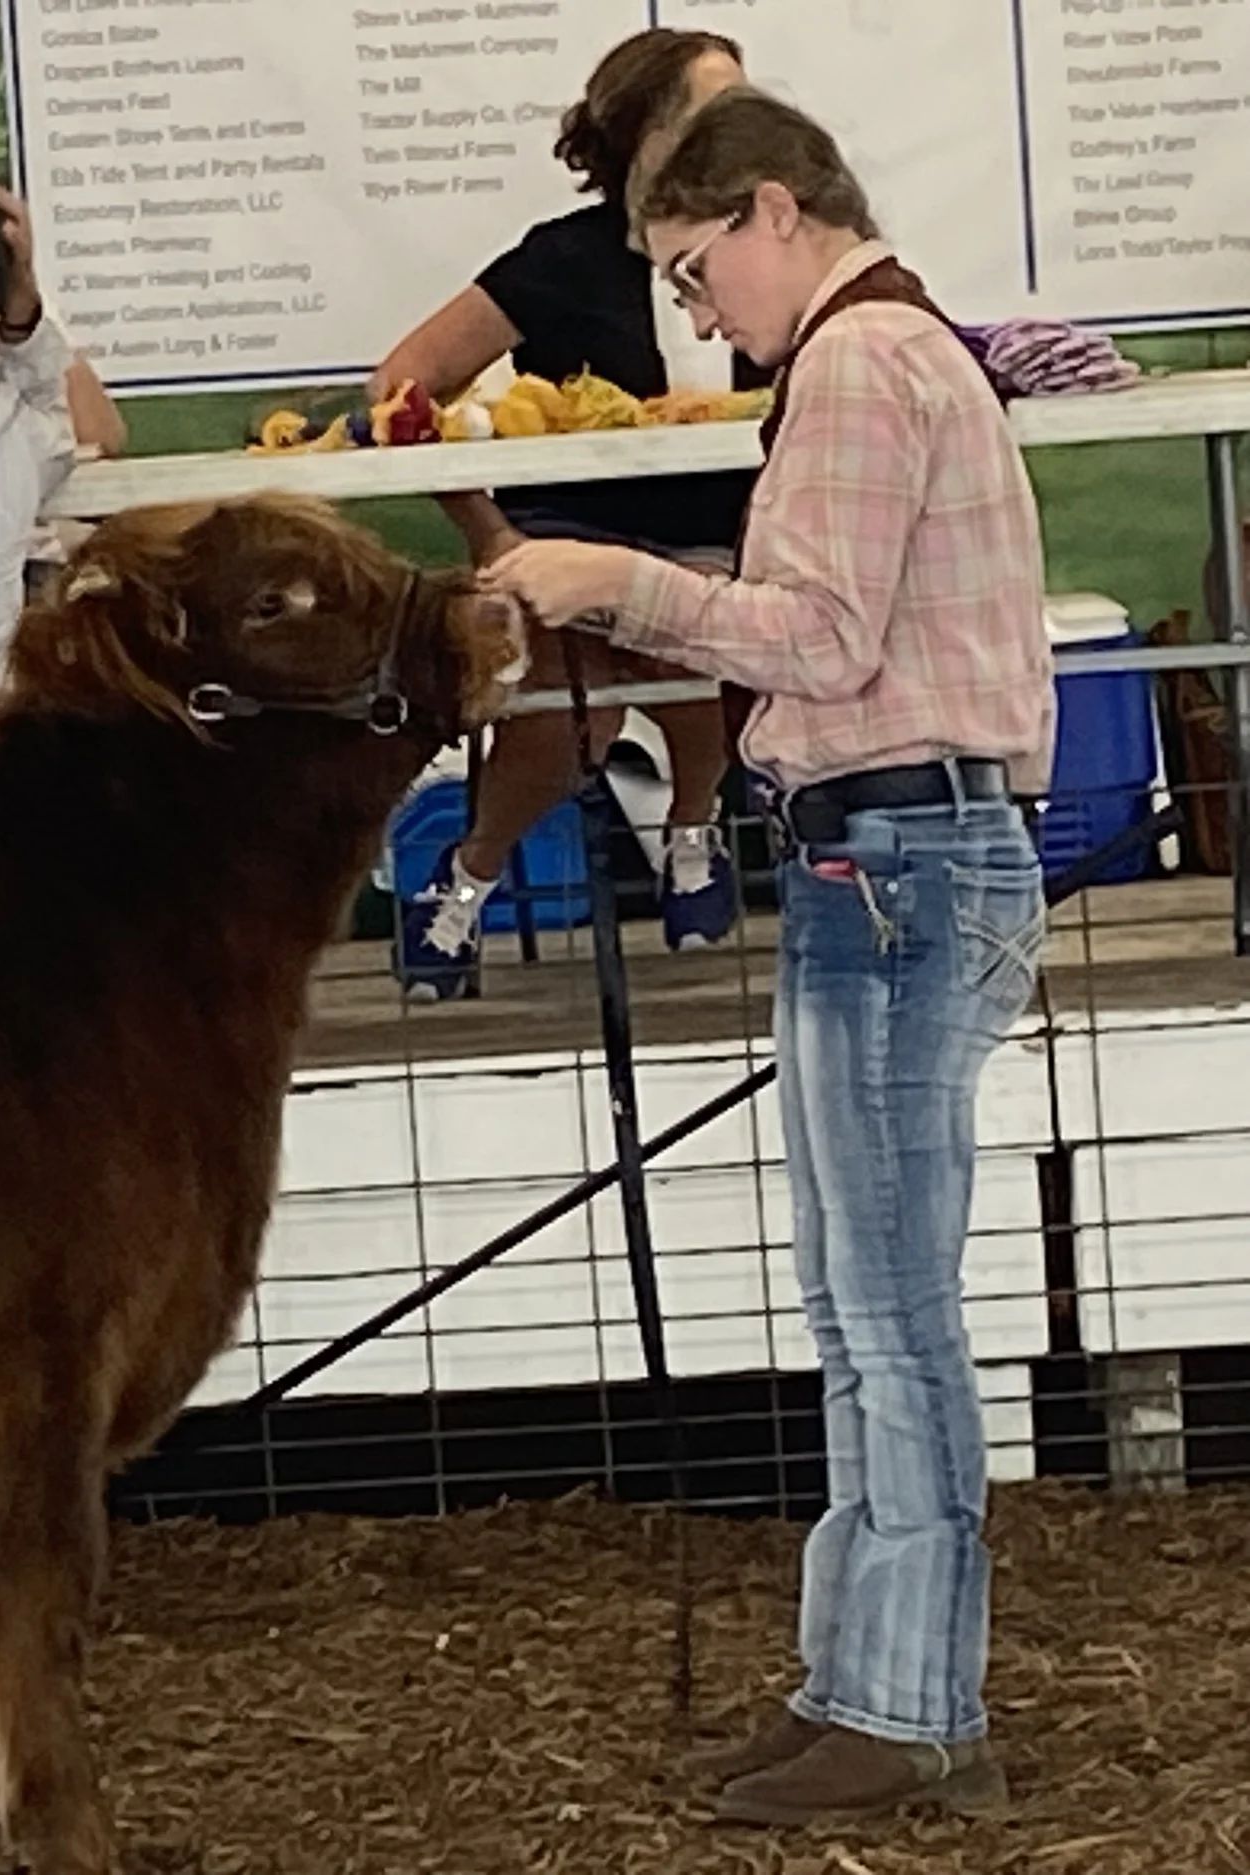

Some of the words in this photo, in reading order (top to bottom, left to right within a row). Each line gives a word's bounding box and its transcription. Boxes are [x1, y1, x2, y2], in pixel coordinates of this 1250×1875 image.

[354, 44, 387, 61] The
[480, 37, 558, 55] Company
[1064, 32, 1108, 49] River
[1110, 28, 1152, 45] View
[113, 59, 181, 77] Brothers
[1169, 59, 1221, 75] Farms
[357, 79, 389, 96] The
[128, 91, 169, 110] Feed
[1067, 106, 1105, 122] True
[1109, 102, 1155, 119] Value
[1160, 97, 1240, 115] Hardware
[359, 112, 417, 130] Tractor
[421, 107, 477, 129] Supply
[48, 132, 111, 149] Eastern
[115, 128, 163, 145] Shore
[215, 121, 246, 139] and
[250, 119, 306, 137] Events
[464, 141, 516, 158] Farms
[50, 168, 85, 186] Ebb
[88, 165, 127, 184] Tide
[130, 163, 169, 181] Tent
[173, 160, 205, 179] and
[210, 158, 256, 179] Party
[261, 153, 327, 173] Rentals
[363, 181, 401, 201] Wye
[405, 179, 448, 195] River
[452, 177, 504, 193] Farms
[53, 204, 135, 222] Economy
[248, 192, 284, 211] LLC
[56, 238, 126, 258] Edwards
[130, 236, 211, 253] Pharmacy
[58, 275, 81, 292] JC
[148, 268, 210, 287] Heating
[214, 265, 244, 283] and
[248, 262, 310, 281] Cooling
[121, 305, 183, 322] Custom
[292, 294, 326, 312] LLC
[165, 338, 205, 356] Long
[209, 335, 223, 351] &
[226, 333, 278, 350] Foster
